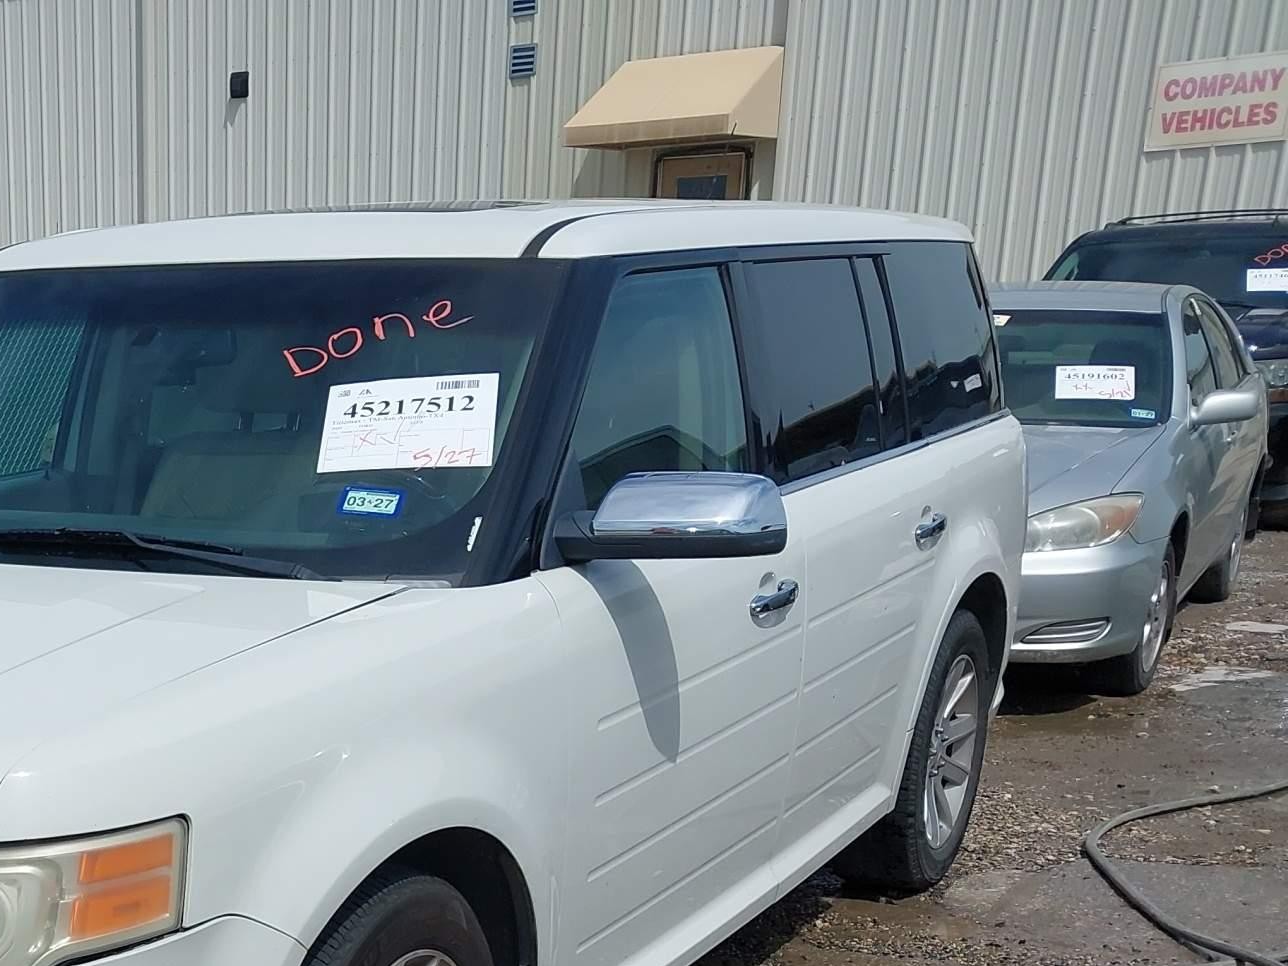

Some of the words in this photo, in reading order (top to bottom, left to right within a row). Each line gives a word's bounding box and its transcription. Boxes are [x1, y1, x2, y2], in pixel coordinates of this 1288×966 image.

[1163, 67, 1286, 102] COMPANY
[1161, 101, 1279, 134] VEHICLES
[1064, 372, 1126, 380] 45191602
[343, 394, 476, 419] 45217512
[413, 444, 482, 472] 5/27
